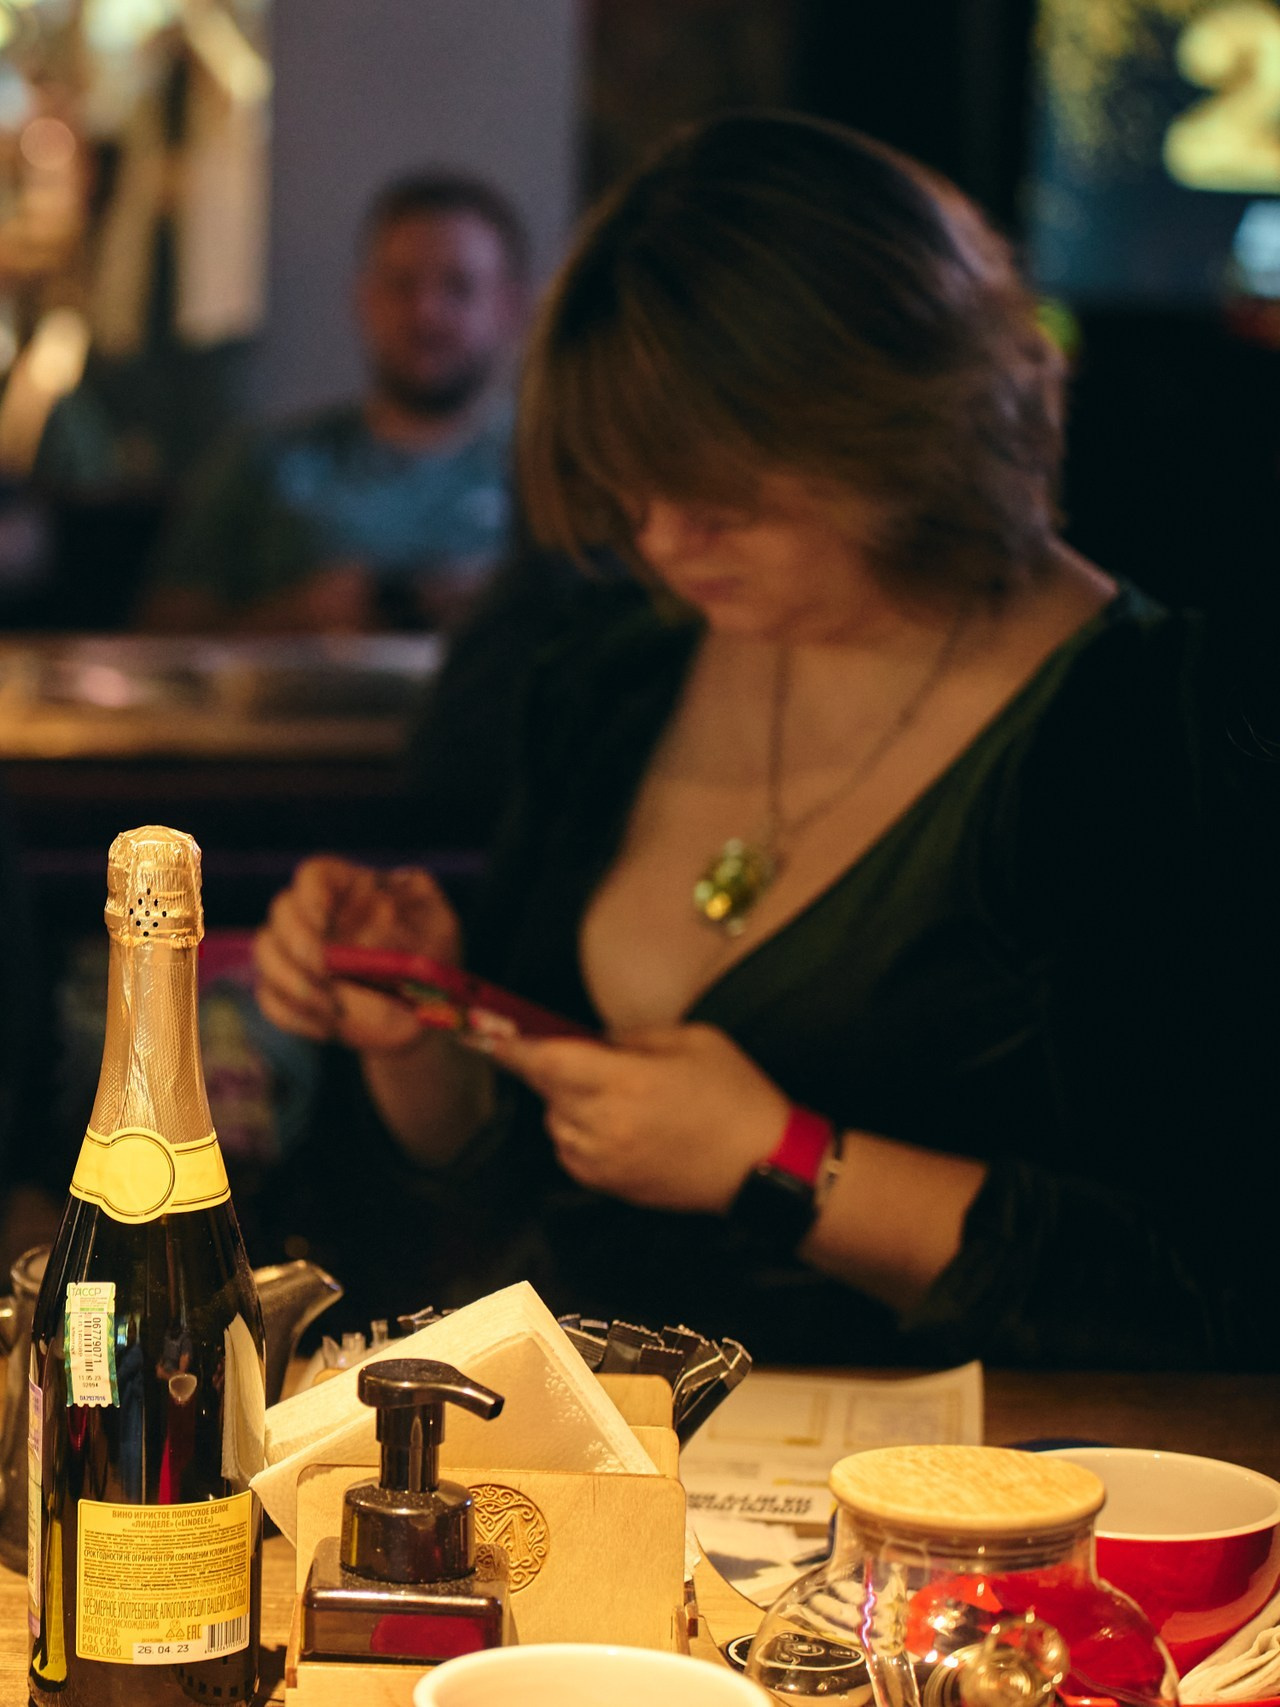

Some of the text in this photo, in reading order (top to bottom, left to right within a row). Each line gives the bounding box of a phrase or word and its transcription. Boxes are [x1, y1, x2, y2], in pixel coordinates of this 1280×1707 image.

[92, 1317, 103, 1364] 06779071
[112, 1503, 229, 1519] ВИНО ИГРИСТОЕ ПОЛУСУХОЕ БЕЛОЕ
[131, 1554, 163, 1562] ОГРАНИЧЕН
[82, 1614, 160, 1630] МЕСТО ПРОИСХОЖДЕНИЯ
[177, 1644, 190, 1653] 23
